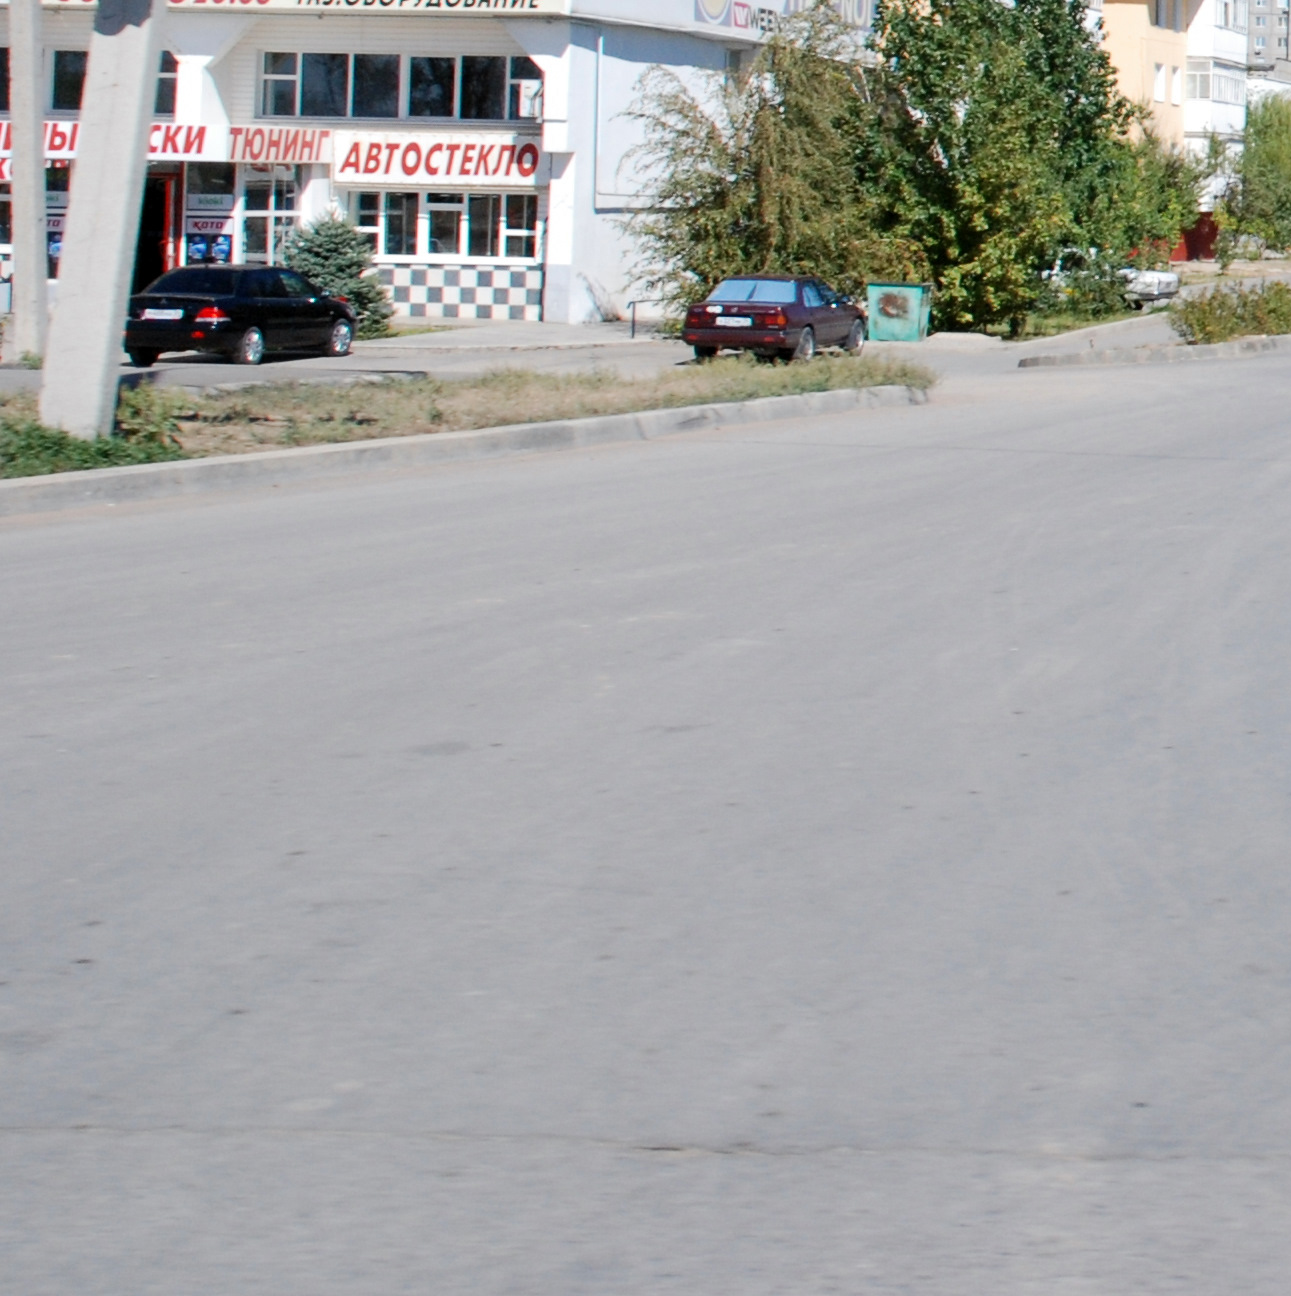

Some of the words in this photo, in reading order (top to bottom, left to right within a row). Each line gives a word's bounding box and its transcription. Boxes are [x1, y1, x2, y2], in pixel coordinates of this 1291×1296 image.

[149, 124, 207, 155] СКИ
[230, 127, 330, 161] ТЮНИНГ
[339, 142, 539, 177] АВТОСТЕКЛО
